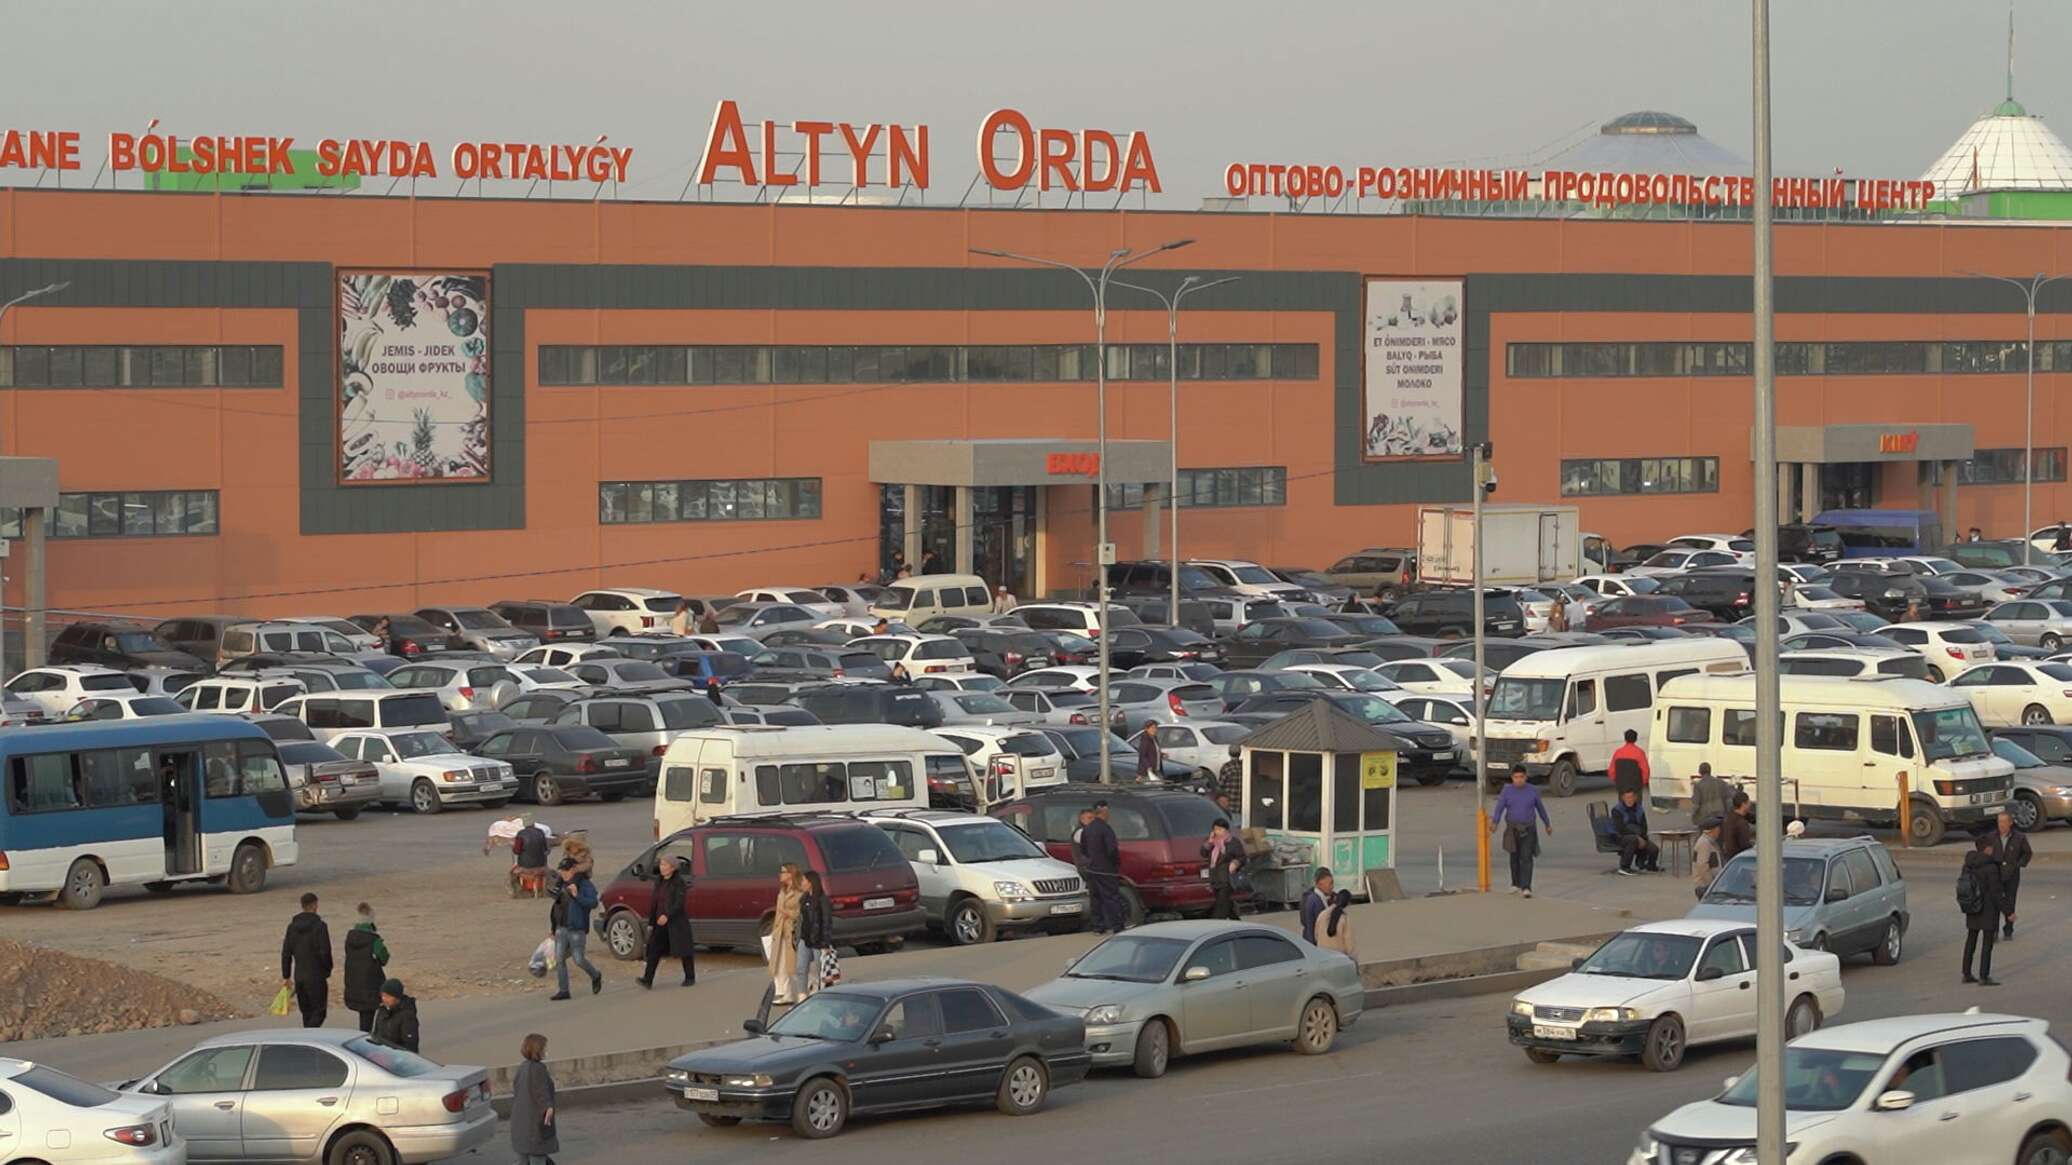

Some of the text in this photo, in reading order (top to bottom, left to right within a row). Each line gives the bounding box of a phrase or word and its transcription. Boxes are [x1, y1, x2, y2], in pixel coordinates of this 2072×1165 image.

[108, 120, 295, 175] BÓLSHEK
[316, 138, 437, 178] SAYDA
[696, 100, 1162, 193] ALTYN ORDA
[1541, 166, 1845, 210] ПРОДОВОЛЬСТВННЫЙ
[1855, 179, 1935, 214] ЦЕНТР
[372, 362, 466, 375] ОВОЩИ ФРУКТЫ
[382, 345, 415, 357] JEMIS
[423, 345, 455, 357] JIDEK
